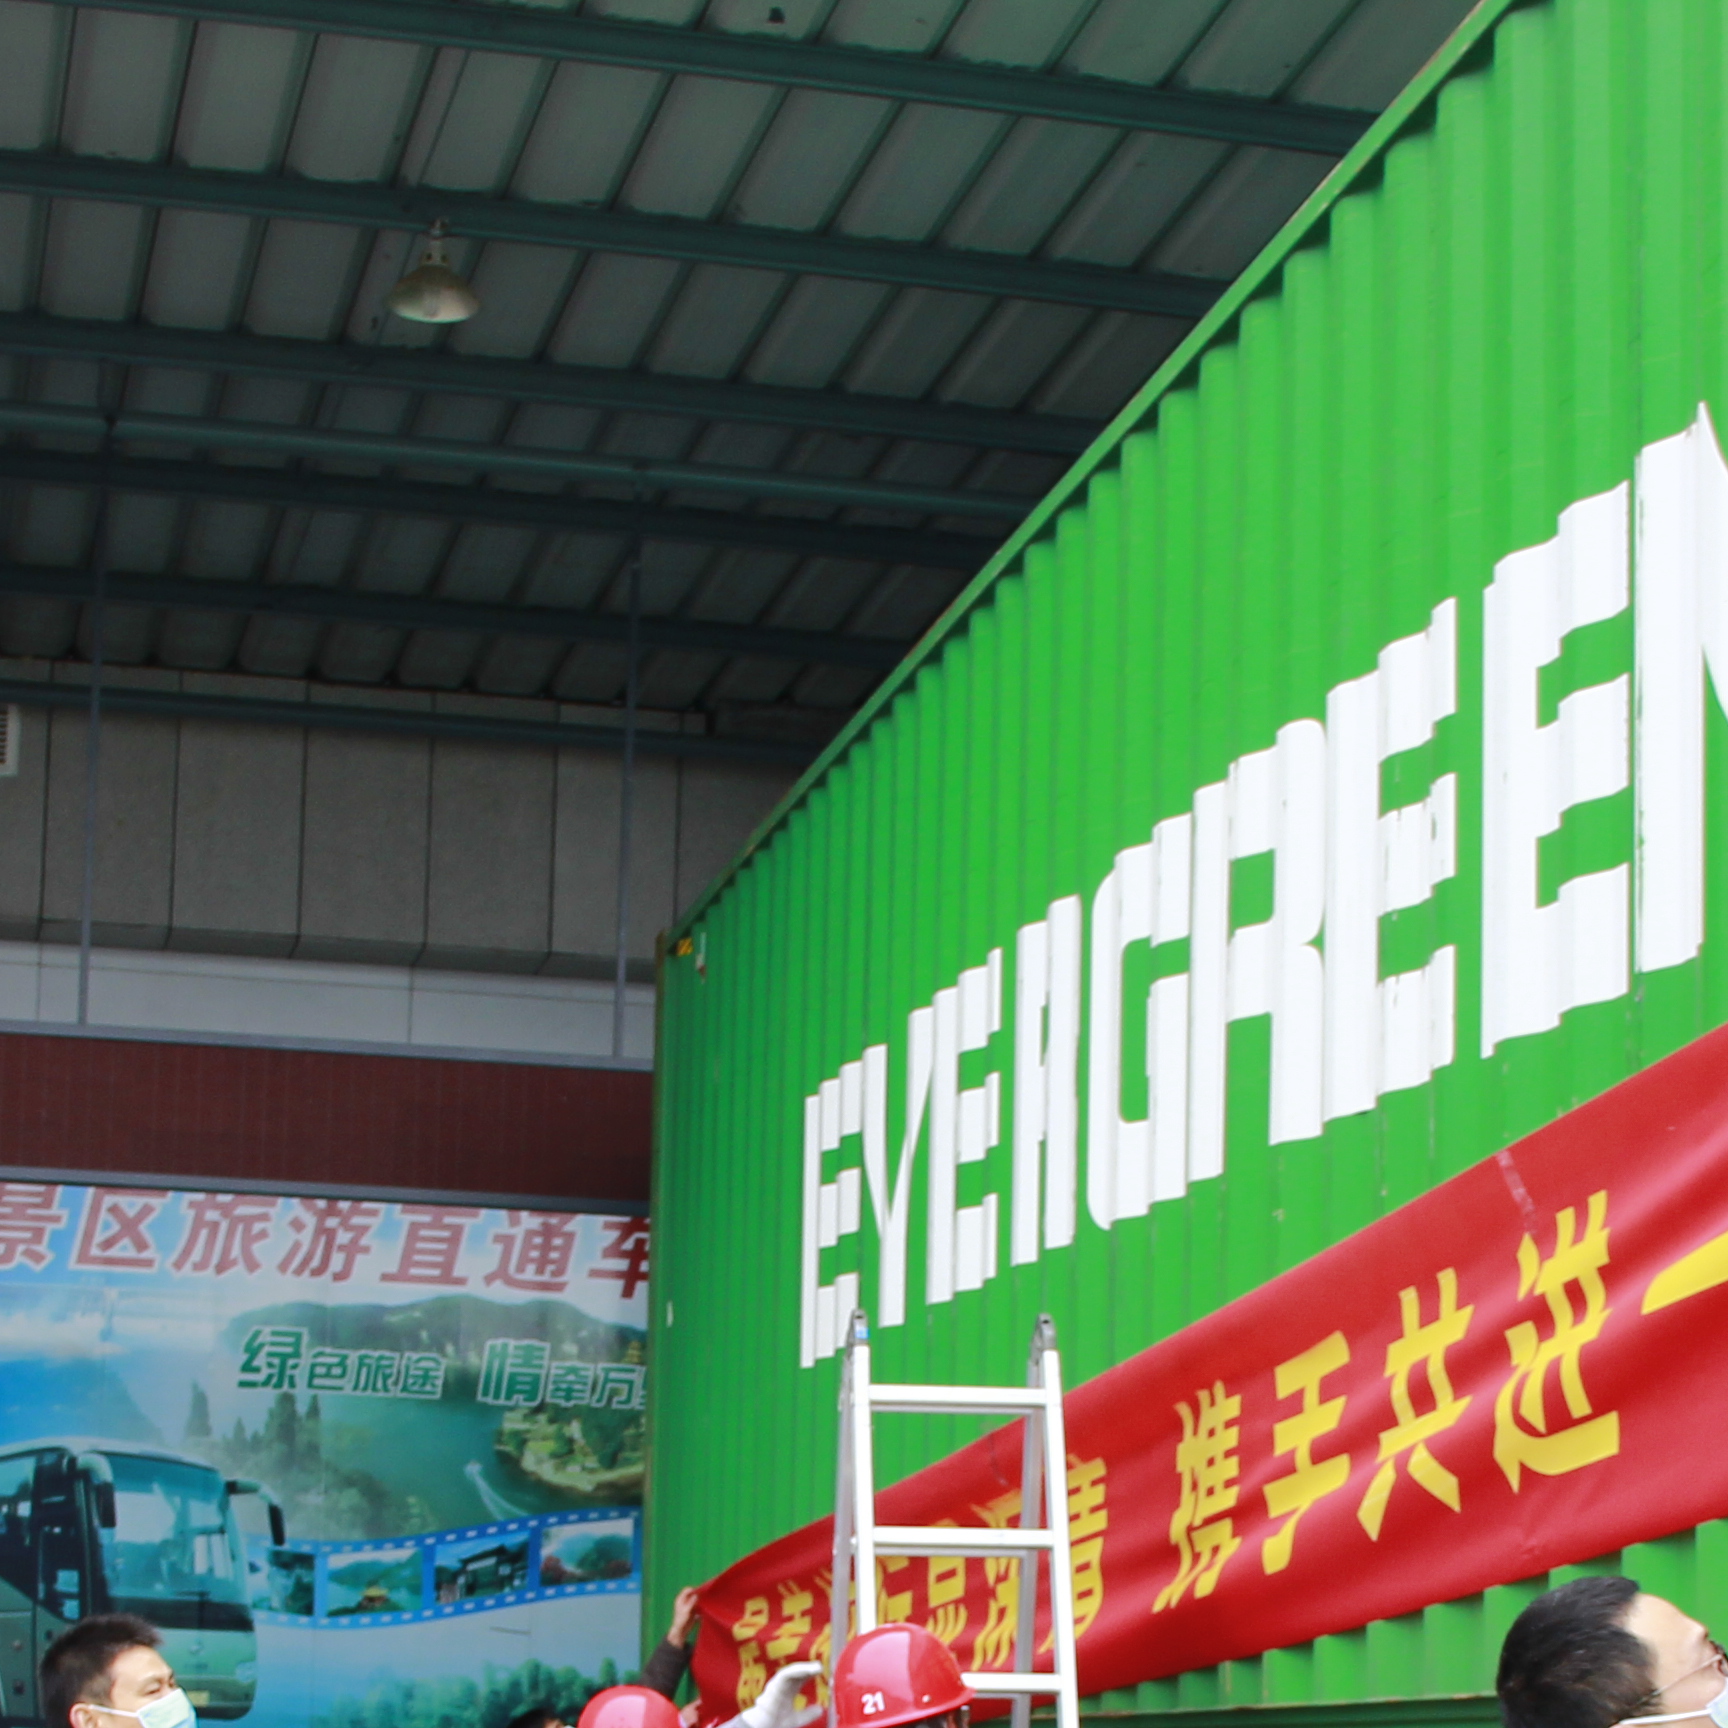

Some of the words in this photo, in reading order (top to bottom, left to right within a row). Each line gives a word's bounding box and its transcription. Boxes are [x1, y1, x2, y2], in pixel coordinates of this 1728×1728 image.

[237, 1327, 444, 1399] 绿色旅途
[479, 1339, 647, 1409] 情牵万
[861, 1691, 886, 1714] 21
